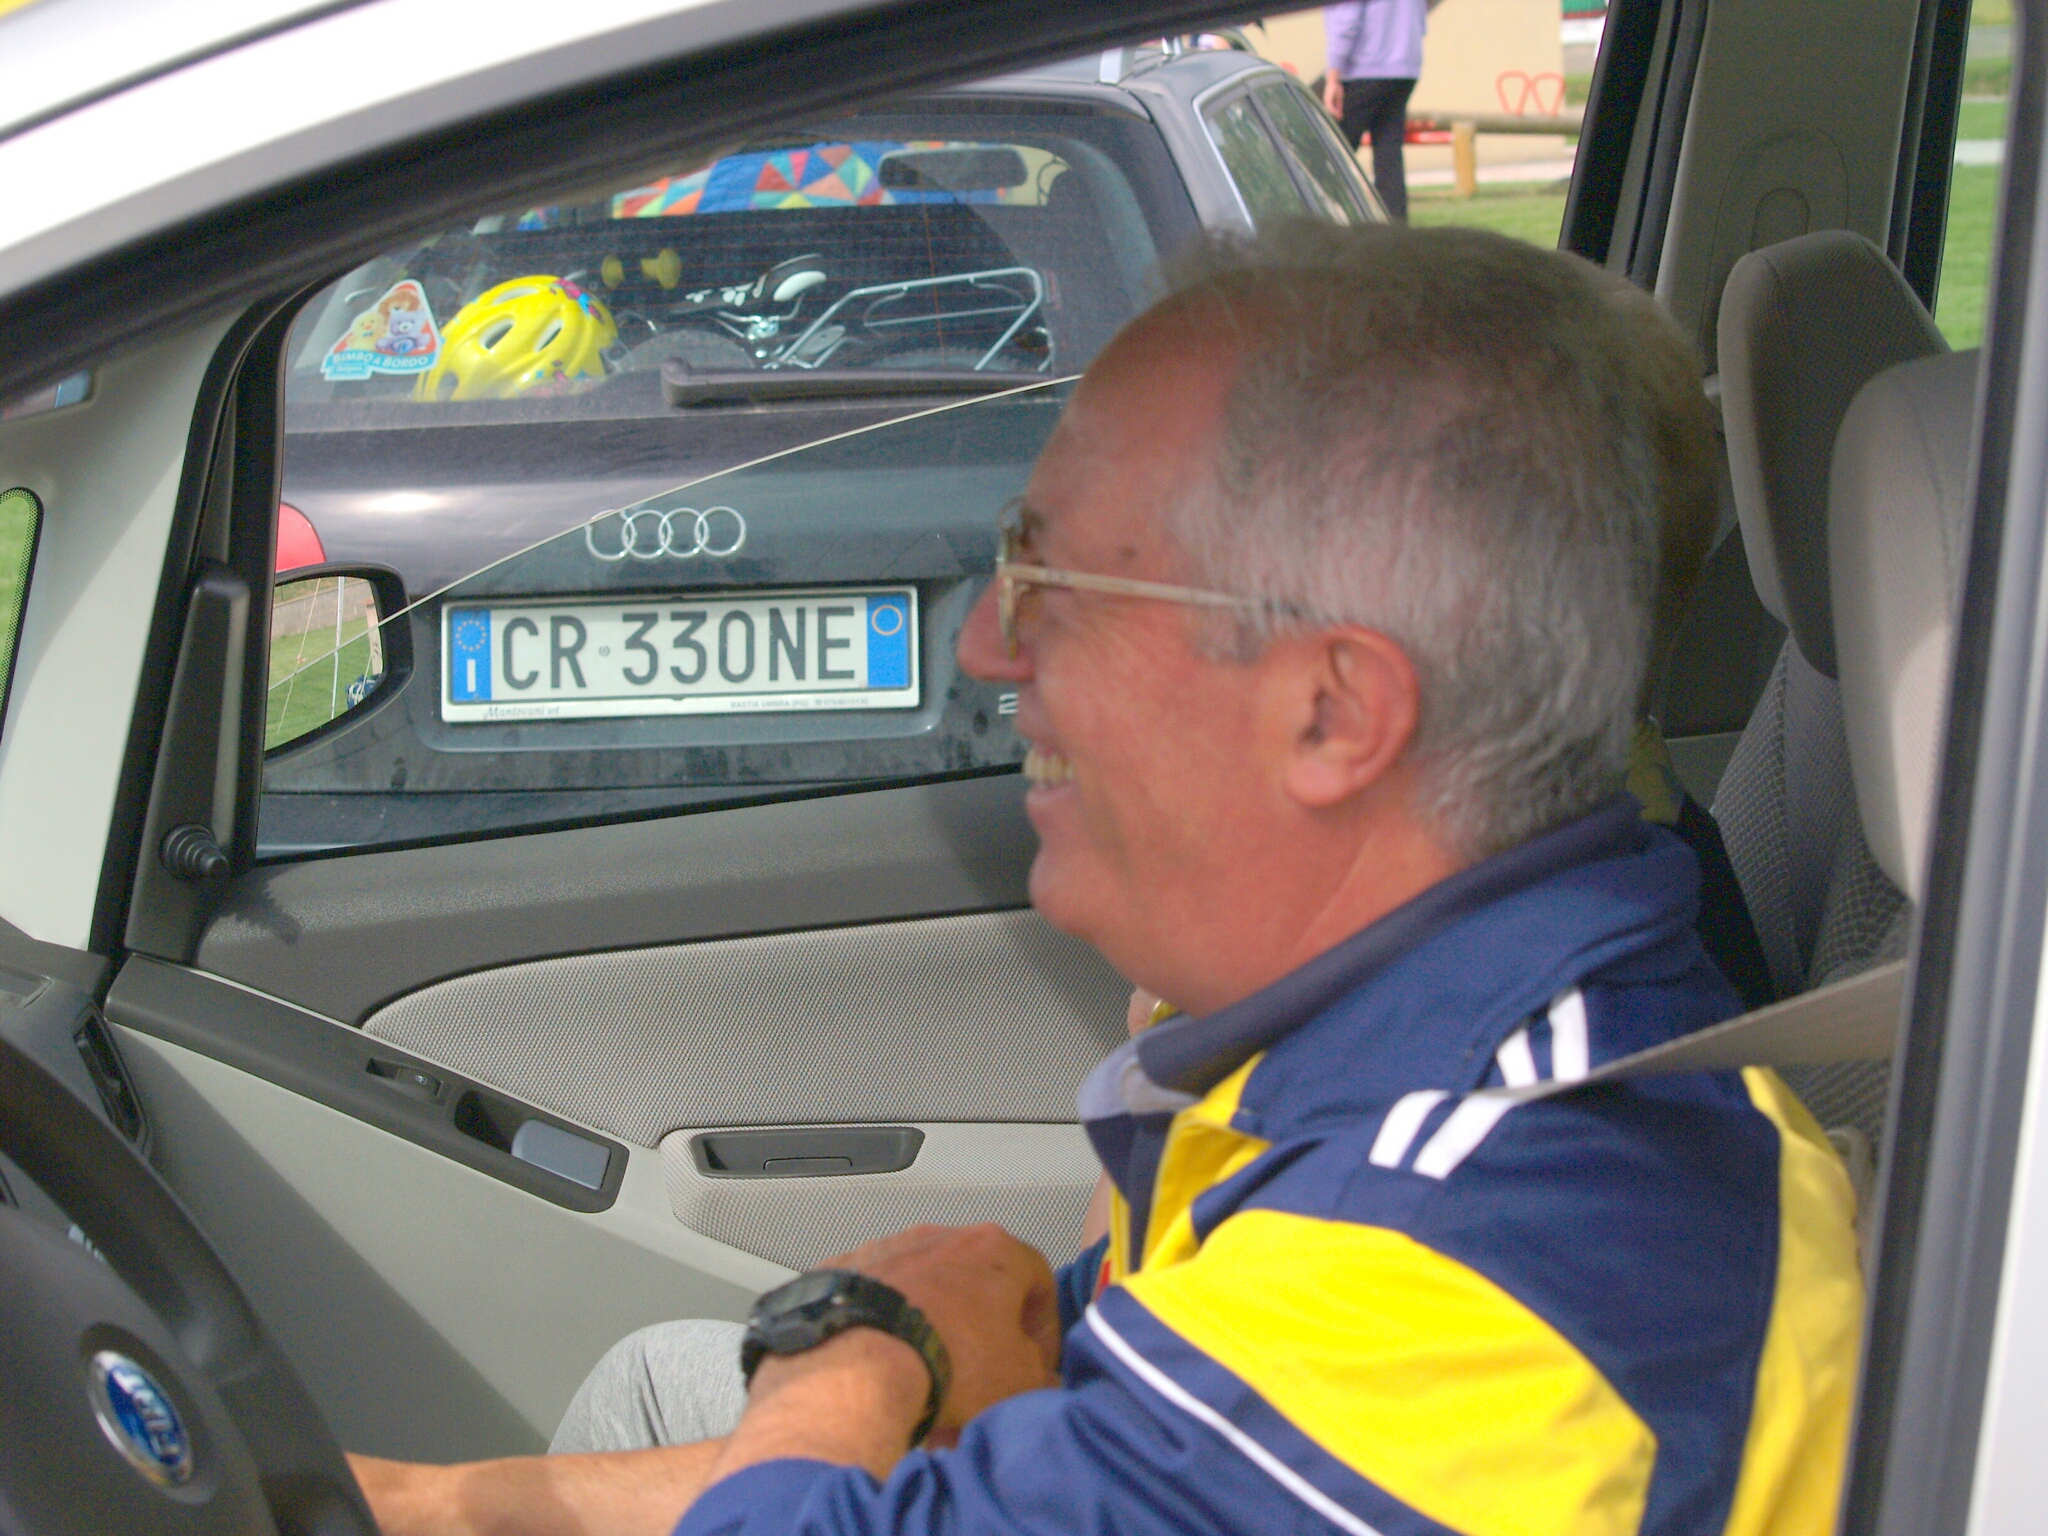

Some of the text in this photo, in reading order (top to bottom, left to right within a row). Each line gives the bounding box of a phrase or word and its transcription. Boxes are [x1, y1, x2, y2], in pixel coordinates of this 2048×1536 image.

[333, 351, 429, 368] BIMBO A BORDO
[502, 606, 855, 690] CR 330NE
